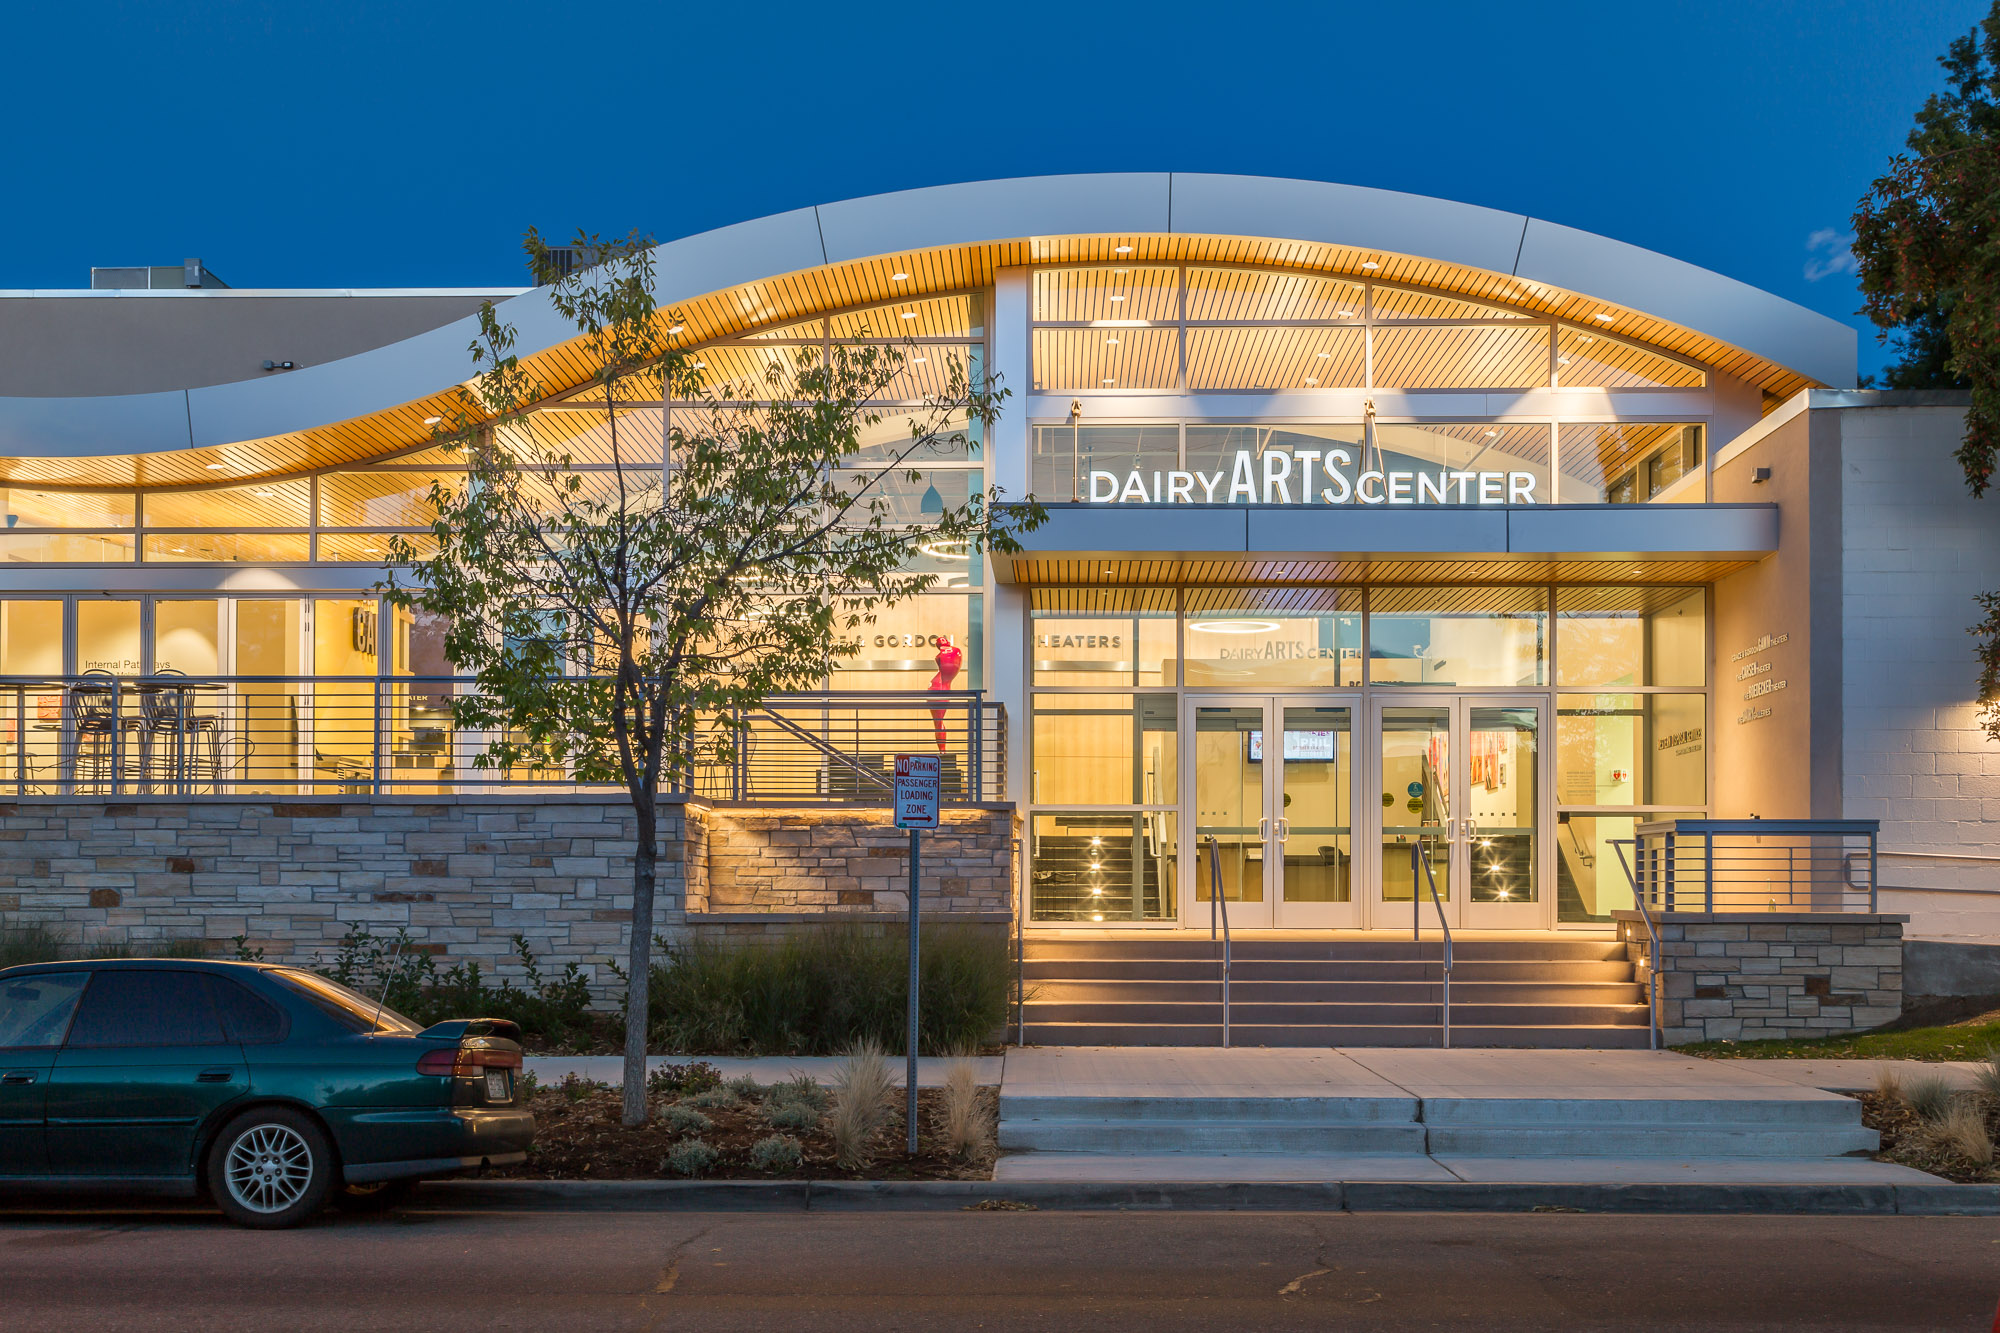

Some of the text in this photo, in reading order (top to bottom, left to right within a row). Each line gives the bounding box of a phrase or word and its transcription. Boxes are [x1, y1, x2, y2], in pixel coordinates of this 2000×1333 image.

[1090, 449, 1536, 504] DAIRY ARTS CENTER
[1220, 648, 1264, 660] DAIRY
[1264, 640, 1304, 660] ARTS
[85, 660, 171, 670] Internal Patays
[897, 759, 937, 773] NO PARKING
[898, 779, 937, 788] PASSENGER
[901, 790, 933, 800] LOADING
[906, 804, 927, 814] ZONE
